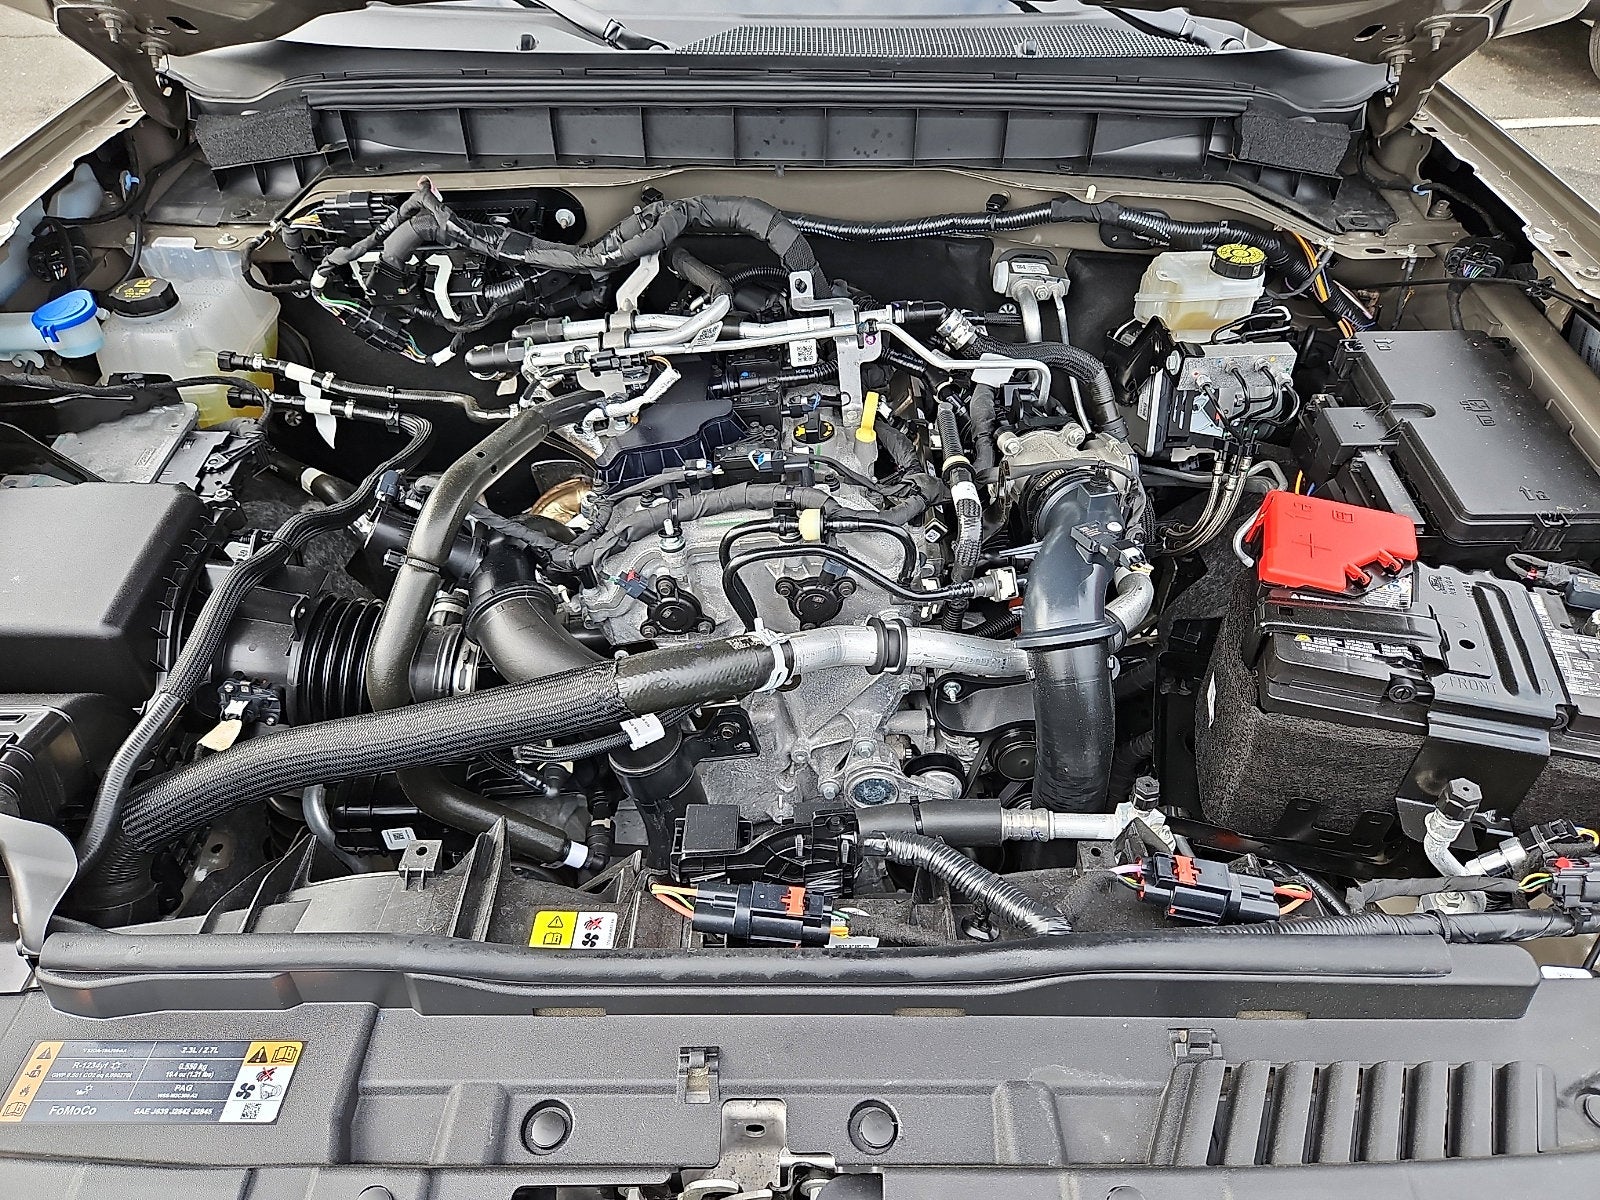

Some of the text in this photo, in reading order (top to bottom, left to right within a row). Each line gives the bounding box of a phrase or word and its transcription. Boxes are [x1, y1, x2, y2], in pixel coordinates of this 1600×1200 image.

[1449, 676, 1497, 694] FRONT
[72, 1061, 109, 1070] R-1234yf
[174, 1084, 193, 1092] PAG
[48, 1105, 97, 1116] FoMoCo
